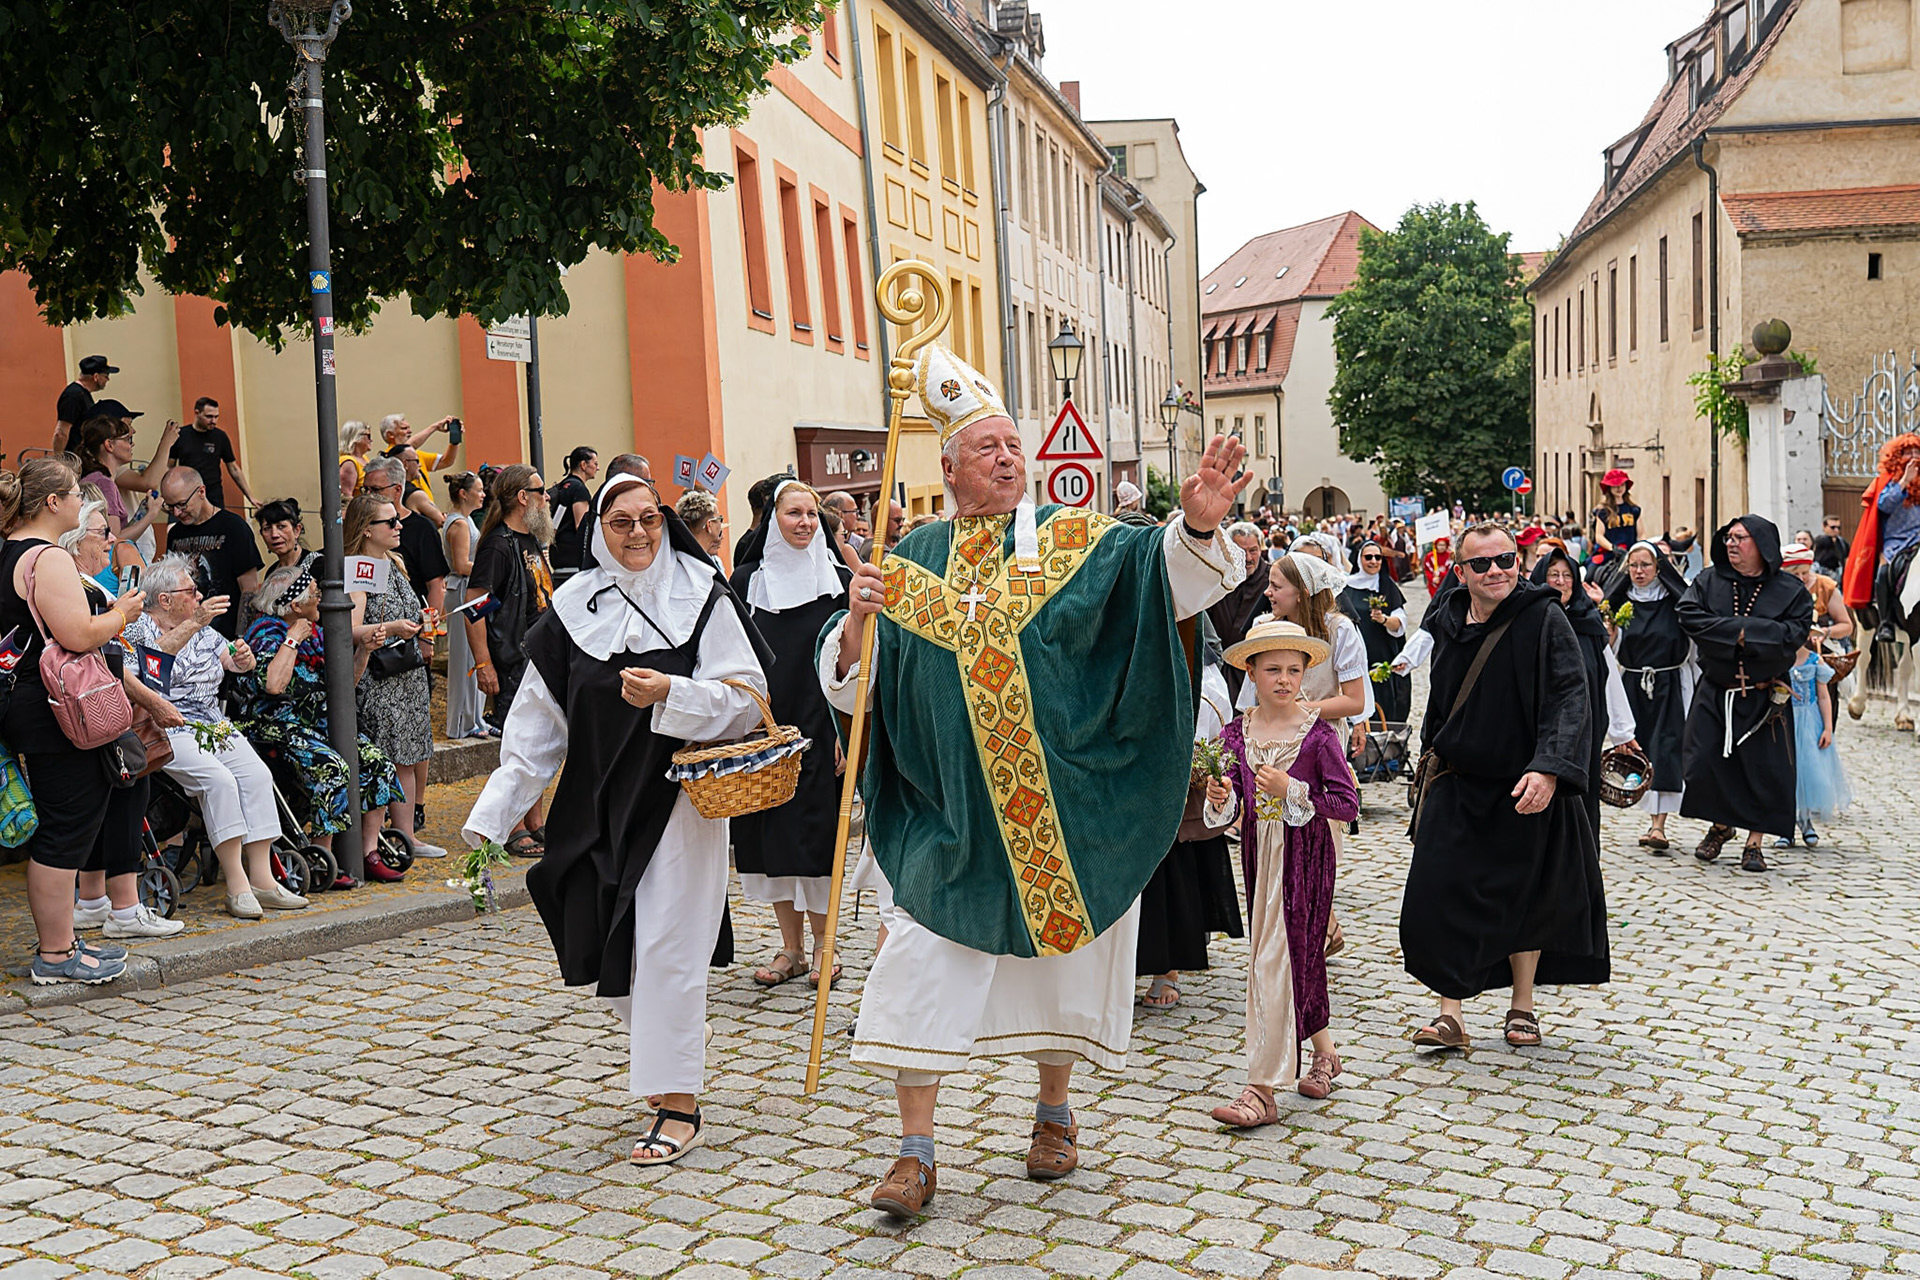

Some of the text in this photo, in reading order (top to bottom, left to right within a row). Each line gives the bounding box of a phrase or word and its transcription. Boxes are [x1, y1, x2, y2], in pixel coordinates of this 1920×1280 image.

[1060, 475, 1083, 498] 10
[357, 563, 373, 578] M
[147, 657, 160, 675] M
